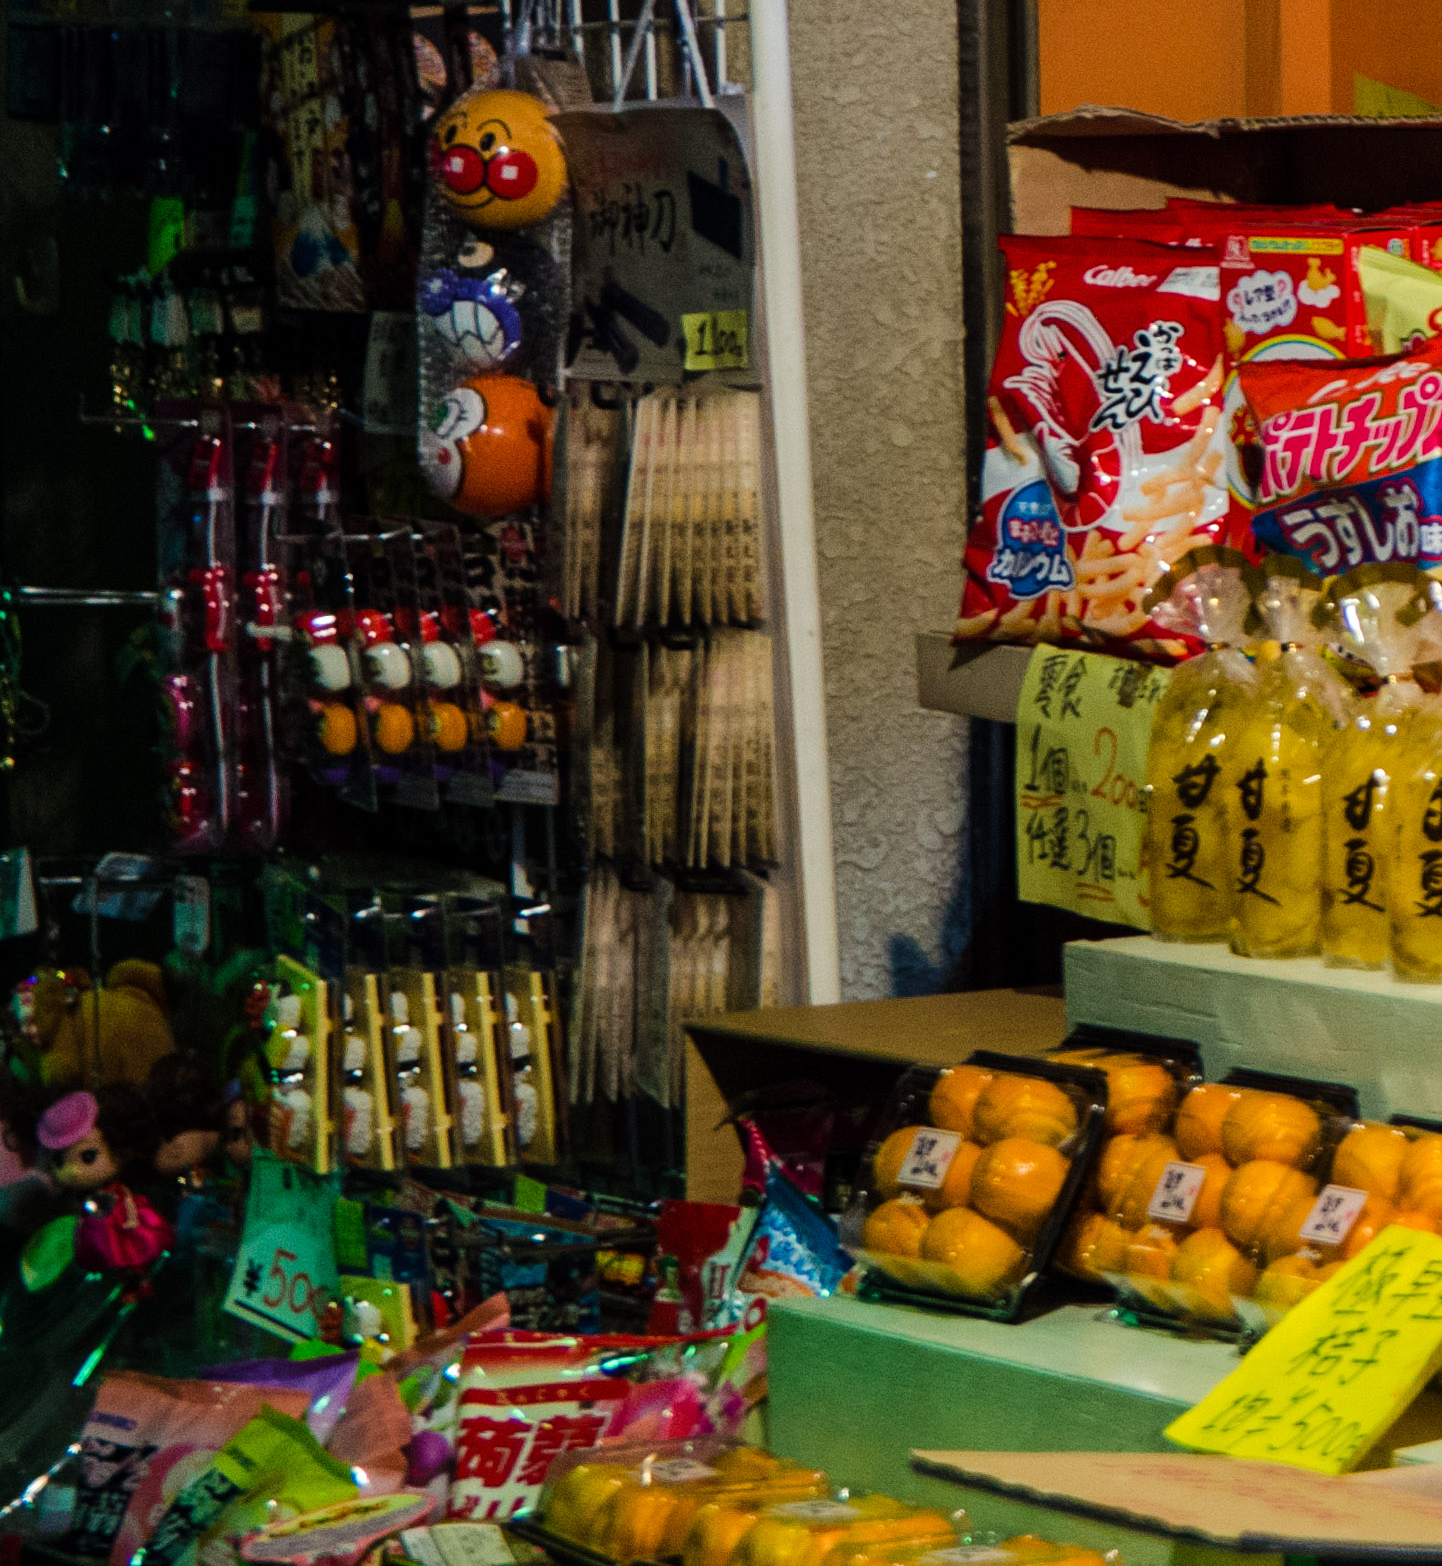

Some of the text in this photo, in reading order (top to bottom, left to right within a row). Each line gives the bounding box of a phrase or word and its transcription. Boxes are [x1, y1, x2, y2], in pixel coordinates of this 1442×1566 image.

[1165, 753, 1222, 892] 甘夏
[1236, 756, 1283, 908] 甘夏
[1338, 775, 1387, 913] 甘夏
